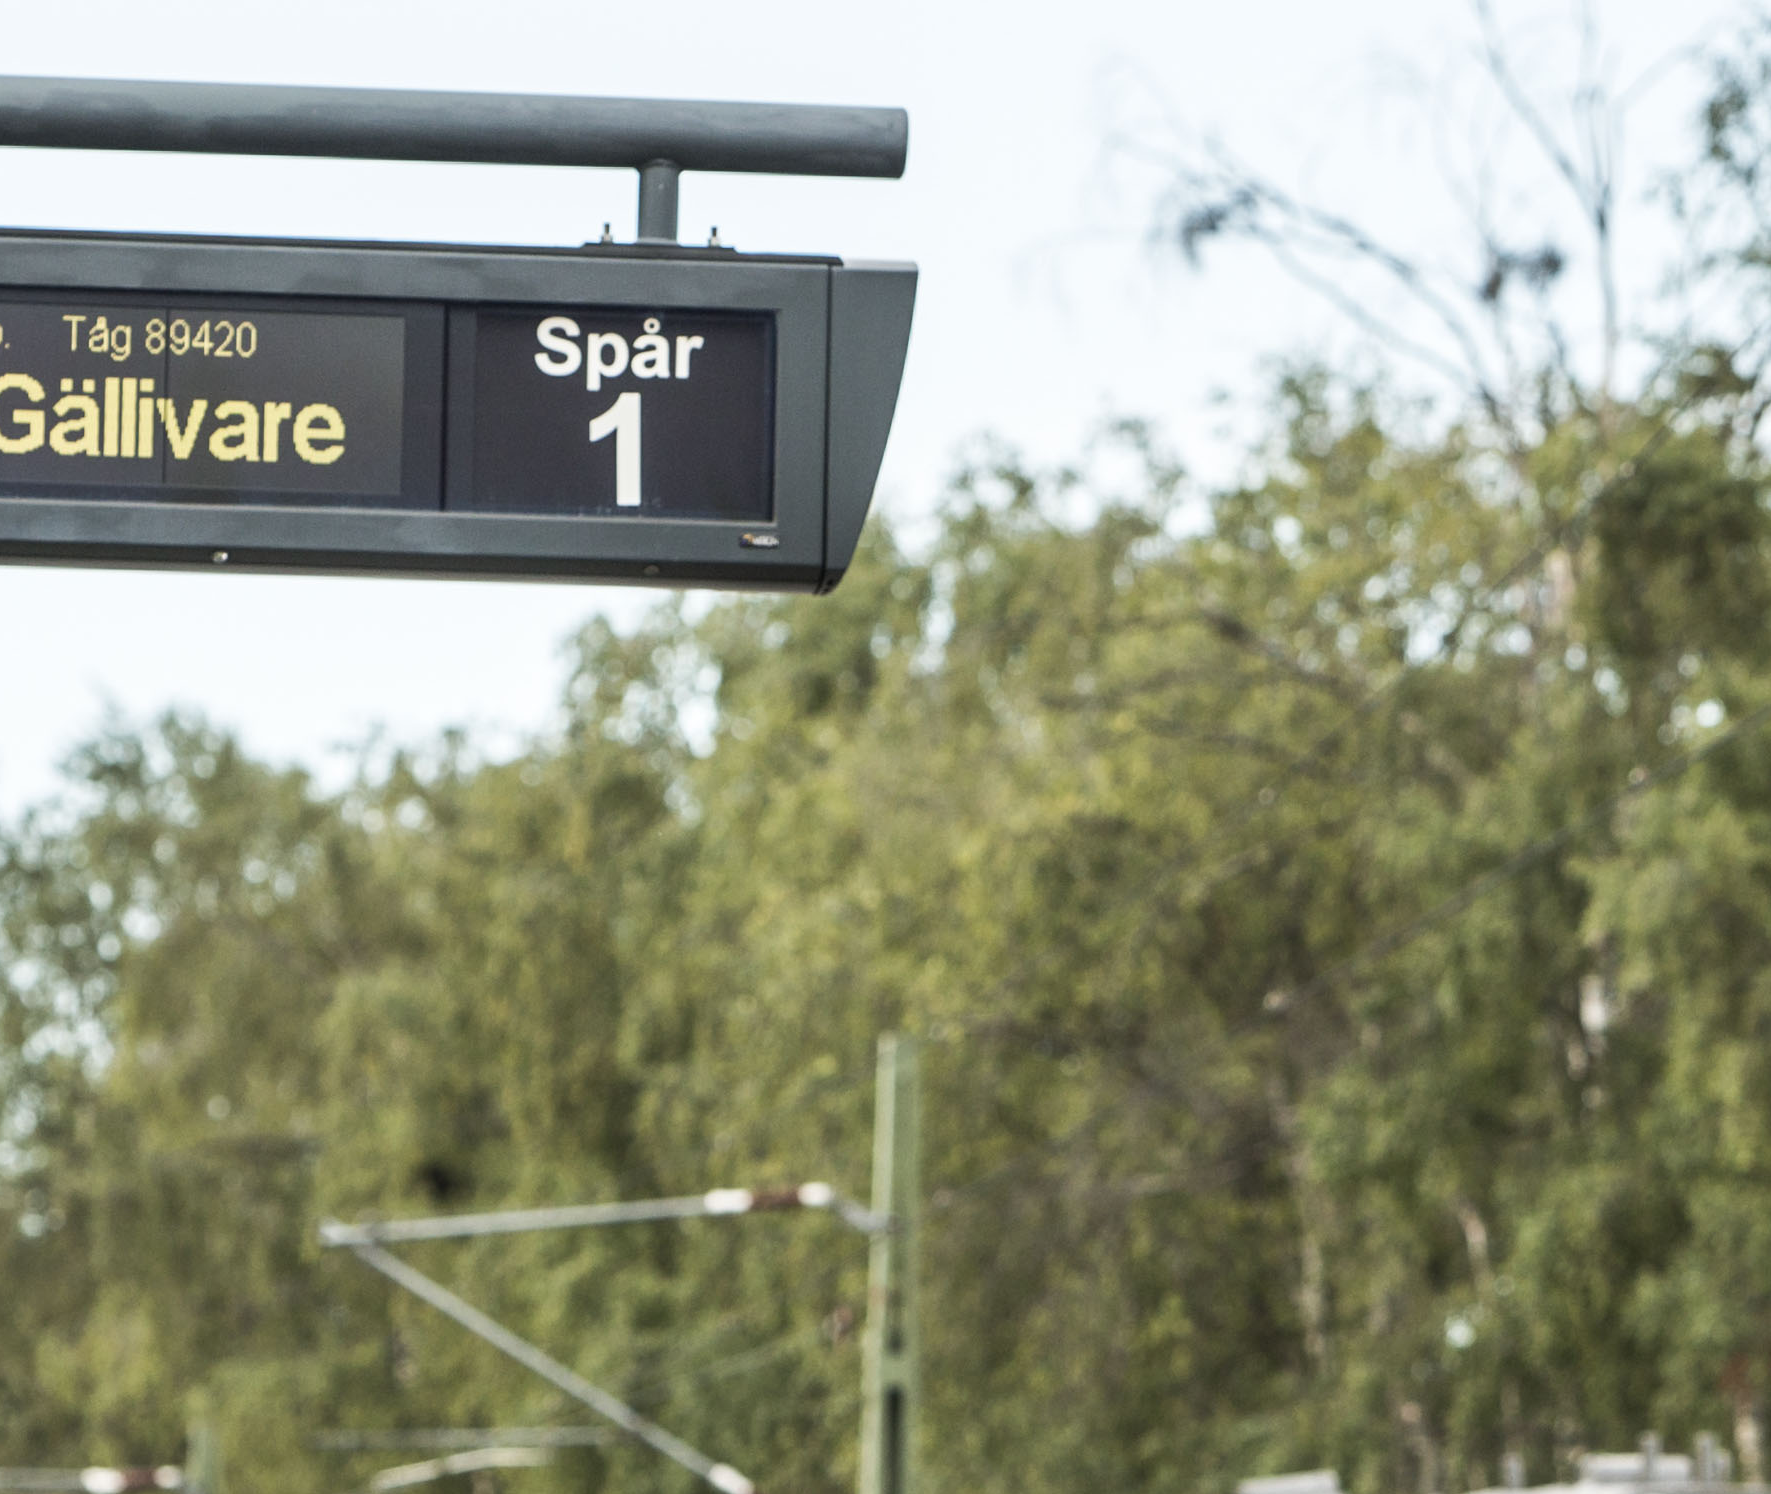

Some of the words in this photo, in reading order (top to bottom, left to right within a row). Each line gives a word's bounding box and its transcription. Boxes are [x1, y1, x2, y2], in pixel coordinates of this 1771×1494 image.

[63, 314, 132, 361] Tåg
[145, 318, 258, 358] 89420
[534, 316, 704, 391] Spår
[589, 392, 641, 506] 1
